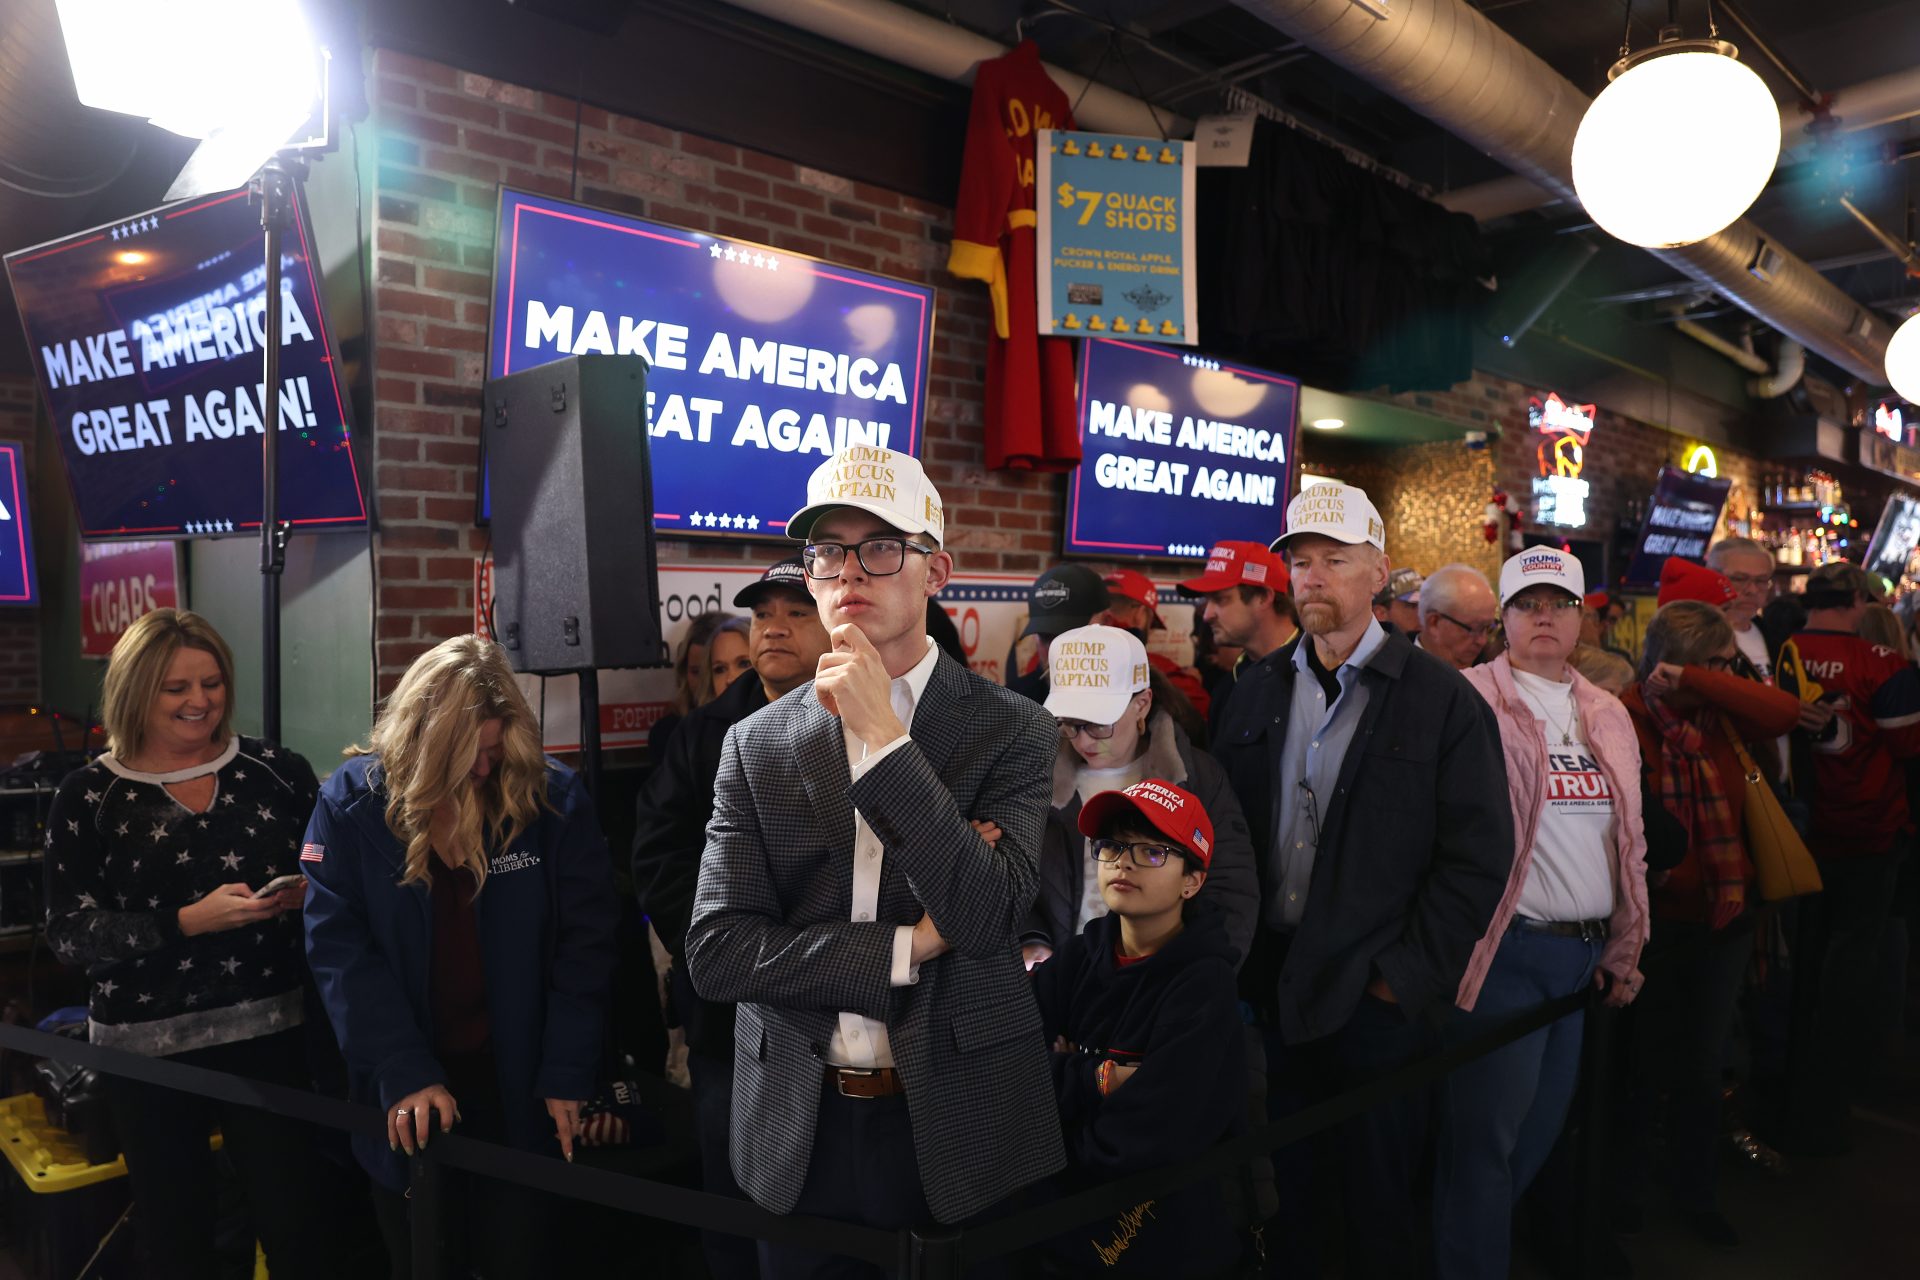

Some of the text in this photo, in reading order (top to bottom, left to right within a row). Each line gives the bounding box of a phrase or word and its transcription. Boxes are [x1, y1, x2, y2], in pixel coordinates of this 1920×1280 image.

[1057, 182, 1176, 226] $7 QUACK
[1105, 210, 1177, 232] SHOTS
[1061, 246, 1102, 258] CROWN
[1104, 250, 1137, 261] ROYAL
[1054, 258, 1181, 275] PUCKER & ENERGY DRINK
[41, 291, 314, 389] MAKE AMERICA
[525, 300, 907, 405] MAKE AMERICA
[646, 391, 724, 443] EAT
[71, 399, 173, 456] GREAT
[1089, 400, 1286, 464] MAKE AMERICA
[835, 446, 892, 465] RUMP
[827, 463, 895, 484] AUCUS
[1095, 453, 1277, 506] GREAT AGAIN!
[825, 481, 897, 503] APTAIN
[1300, 486, 1343, 503] TRUMP
[1294, 499, 1345, 516] CAUCUS
[1291, 511, 1346, 530] CAPTAIN
[1522, 554, 1560, 565] TRUMP
[1522, 562, 1562, 573] COUNTRY
[768, 566, 806, 577] TRUMP
[91, 574, 158, 636] CIGARS
[660, 583, 722, 623] ood
[1061, 641, 1106, 656] TRUMP
[1055, 657, 1109, 672] CAUCUS
[1053, 673, 1111, 688] CAPTAIN
[1549, 754, 1601, 771] TEA
[1136, 782, 1185, 808] AMERICA
[1549, 773, 1610, 797] TRU
[1140, 790, 1178, 813] AGAIN
[491, 850, 530, 866] MOMS for
[493, 856, 537, 874] LIBERTY
